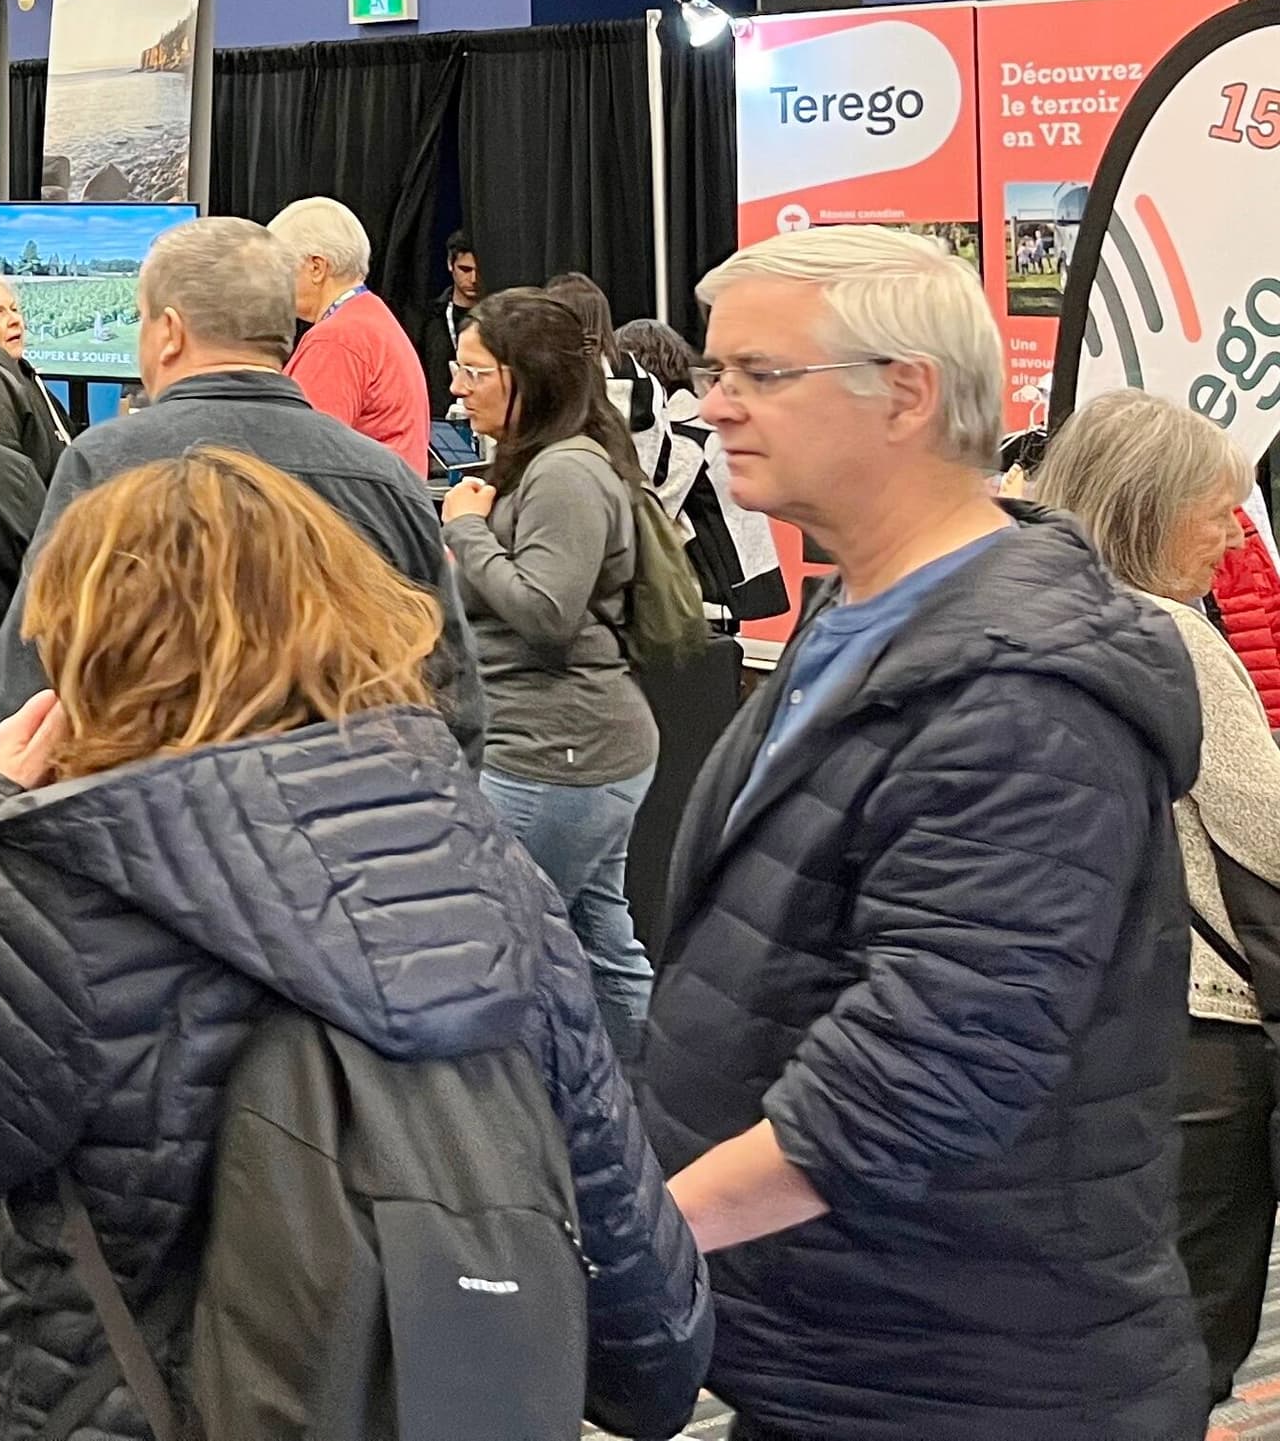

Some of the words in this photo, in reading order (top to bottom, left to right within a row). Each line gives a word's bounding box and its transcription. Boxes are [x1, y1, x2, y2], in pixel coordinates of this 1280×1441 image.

[1000, 61, 1144, 86] Découvrez
[769, 85, 924, 136] Terego
[1001, 94, 1026, 117] le
[1030, 89, 1121, 116] terroir
[1002, 129, 1035, 148] en
[1038, 121, 1083, 146] VR
[66, 351, 81, 361] LE
[1009, 338, 1038, 352] Une
